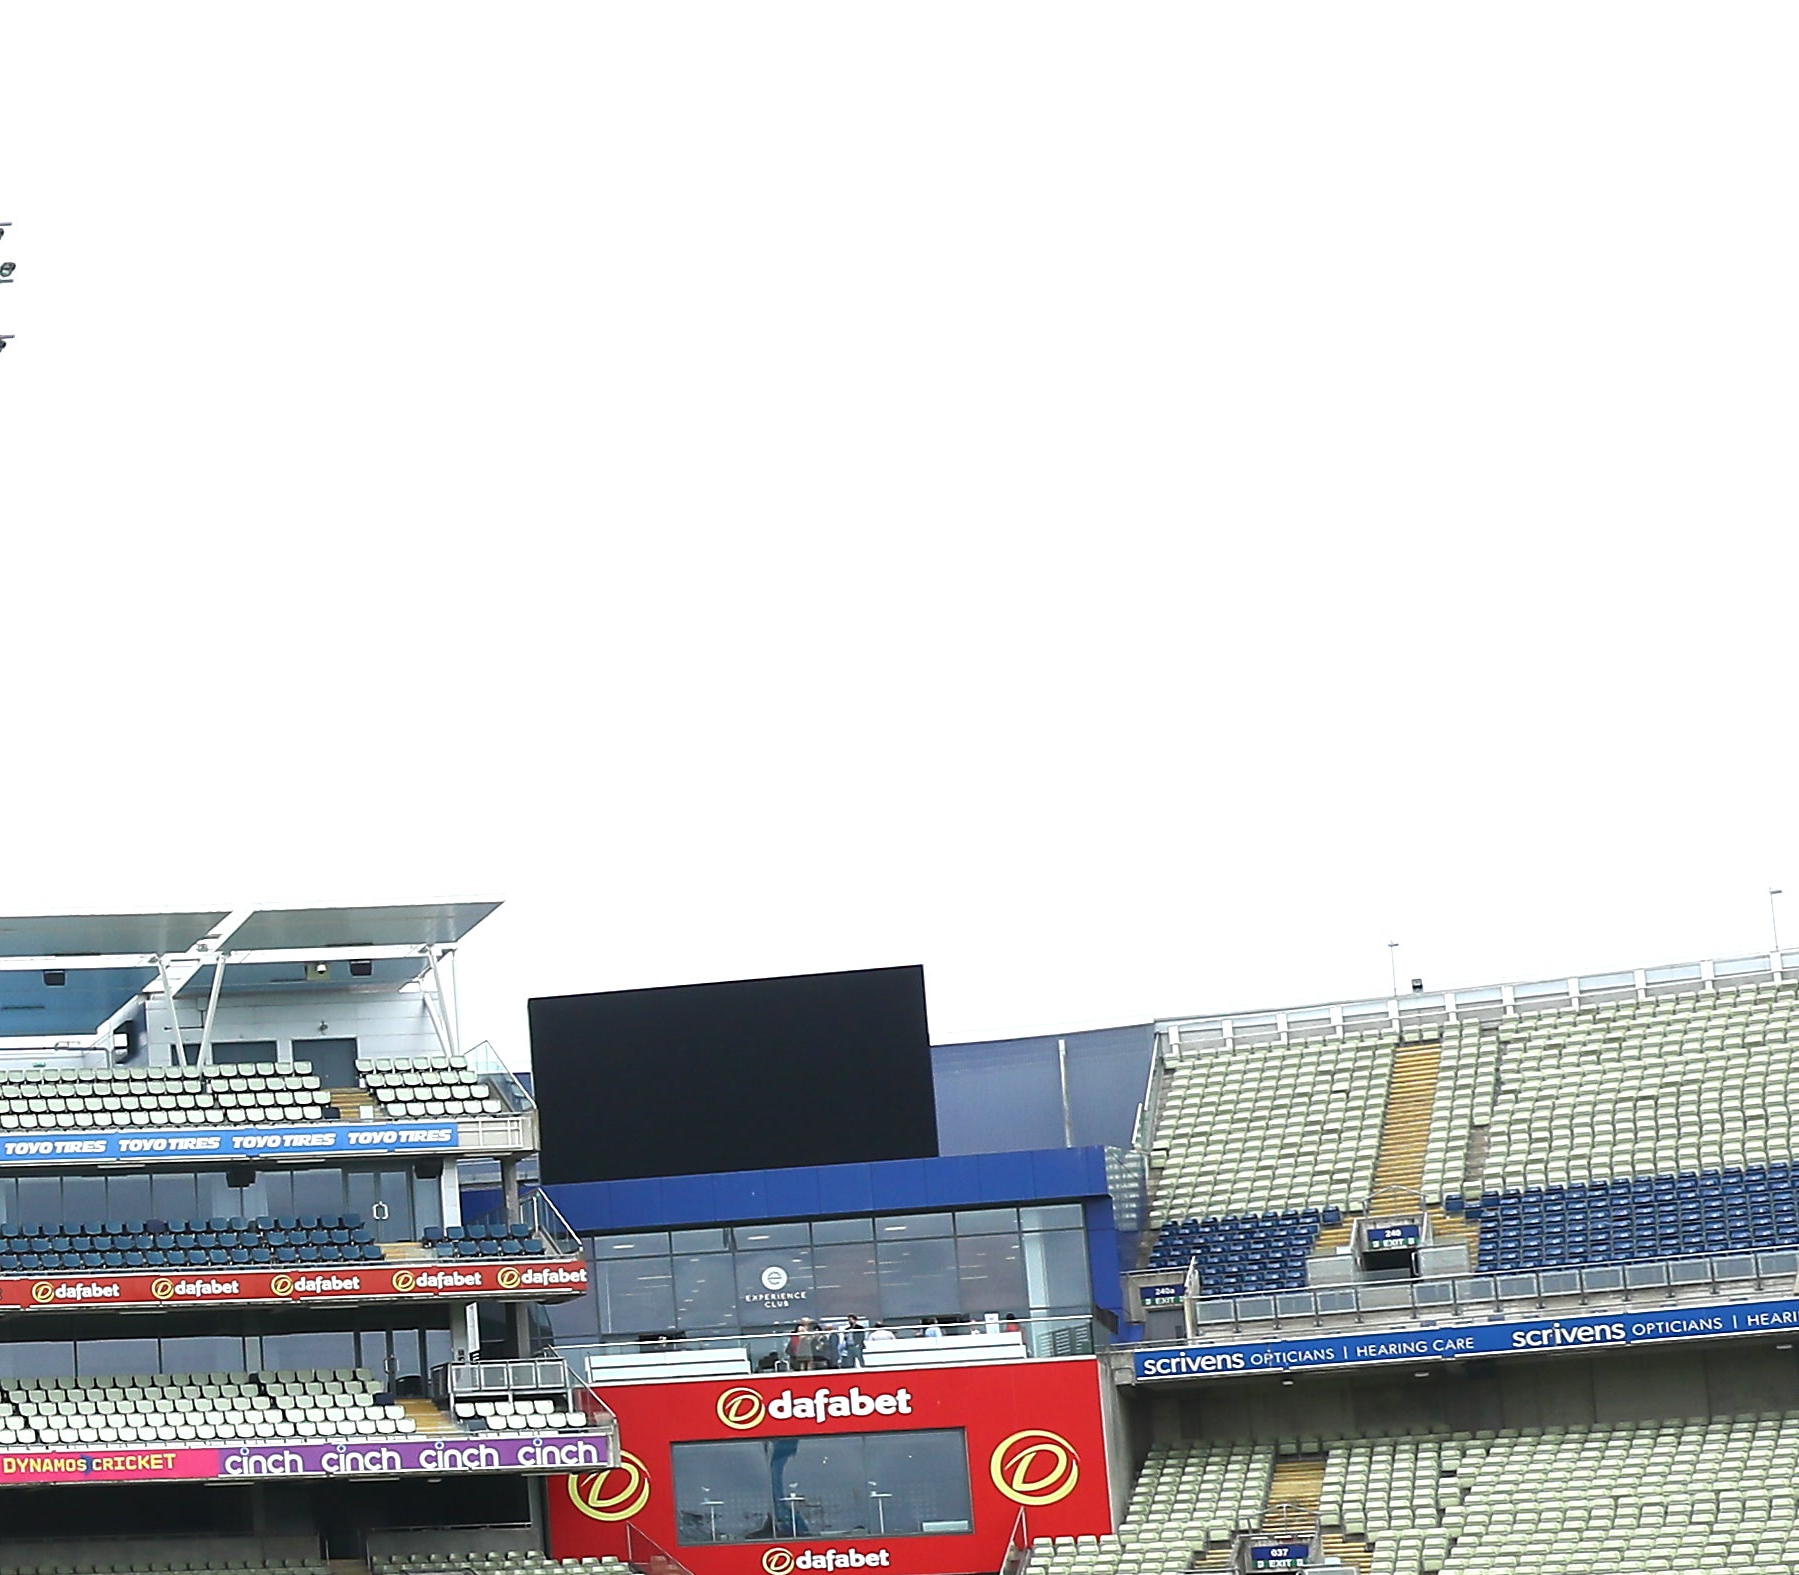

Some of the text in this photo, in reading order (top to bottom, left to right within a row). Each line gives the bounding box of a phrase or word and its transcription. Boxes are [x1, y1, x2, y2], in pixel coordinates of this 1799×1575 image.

[118, 1137, 221, 1152] TOYO TIRES
[232, 1133, 336, 1148] TOYO TIRES
[348, 1129, 452, 1145] TOYO TIRES
[5, 1140, 106, 1155] TOYO TIRES
[294, 1275, 360, 1293] dafabet
[416, 1271, 482, 1289] dafabet
[521, 1268, 587, 1286] dafabet
[56, 1282, 120, 1300] dafabet
[175, 1279, 240, 1297] dafabet
[1512, 1311, 1799, 1349] scrivens OPTICIANS HEARI
[1143, 1337, 1475, 1376] scrivens OPTICIANS HEARING CARE
[767, 1386, 912, 1424] dafabet
[225, 1446, 303, 1475] cinch
[322, 1444, 401, 1473] cinch
[419, 1441, 499, 1470] cinch
[517, 1438, 598, 1466] cinch
[3, 1453, 176, 1474] DYNAMOS CRICKET
[796, 1548, 890, 1572] dafabet
[1270, 1548, 1289, 1556] 037
[1269, 1559, 1292, 1567] EXIT
